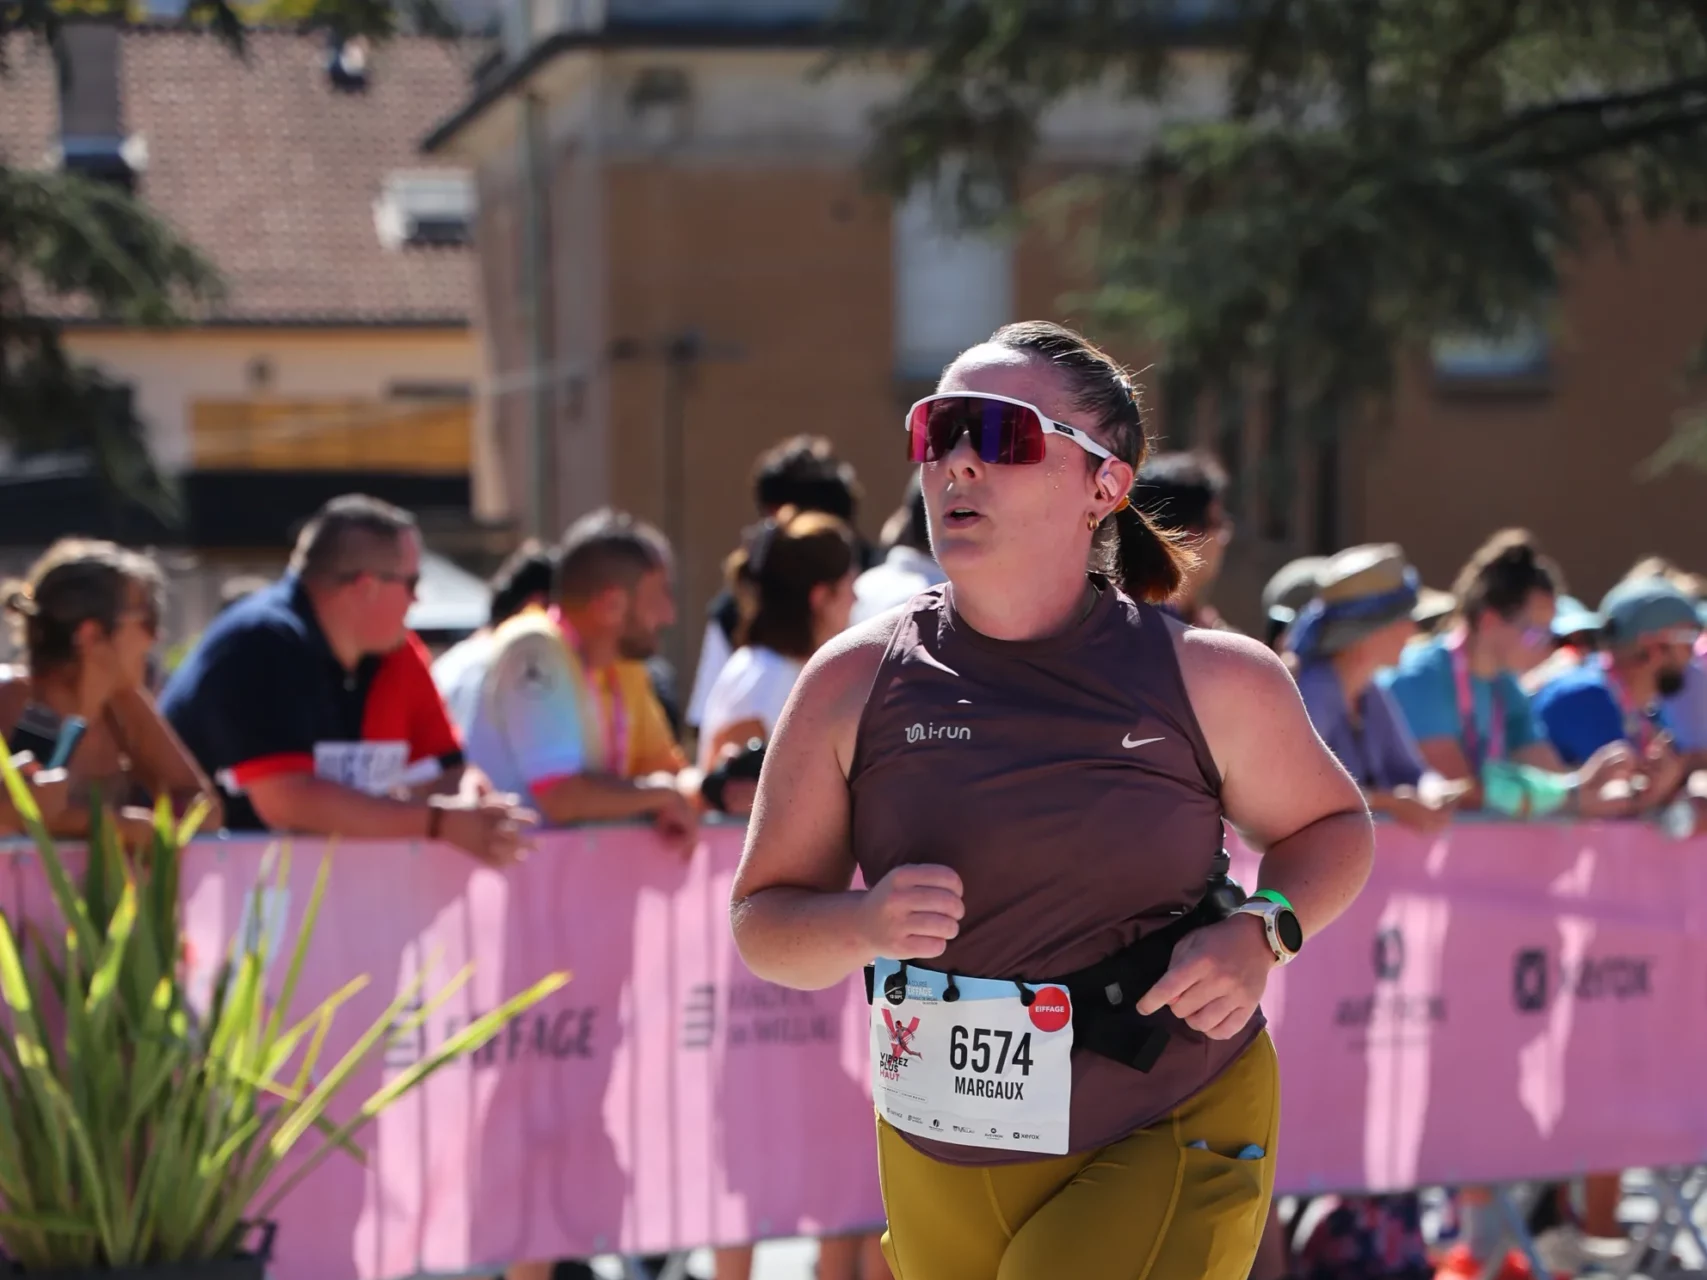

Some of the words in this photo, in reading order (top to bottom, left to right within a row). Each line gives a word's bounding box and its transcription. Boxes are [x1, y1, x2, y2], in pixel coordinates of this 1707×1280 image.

[928, 722, 971, 740] i-run
[1034, 1005, 1065, 1014] EIFFAGE
[949, 1024, 1034, 1077] 6574
[880, 1052, 909, 1067] VIBREZ
[880, 1060, 899, 1073] PLUS
[879, 1069, 900, 1082] HAUT
[954, 1076, 1024, 1101] MARGAUX
[1020, 1132, 1040, 1141] xerox
